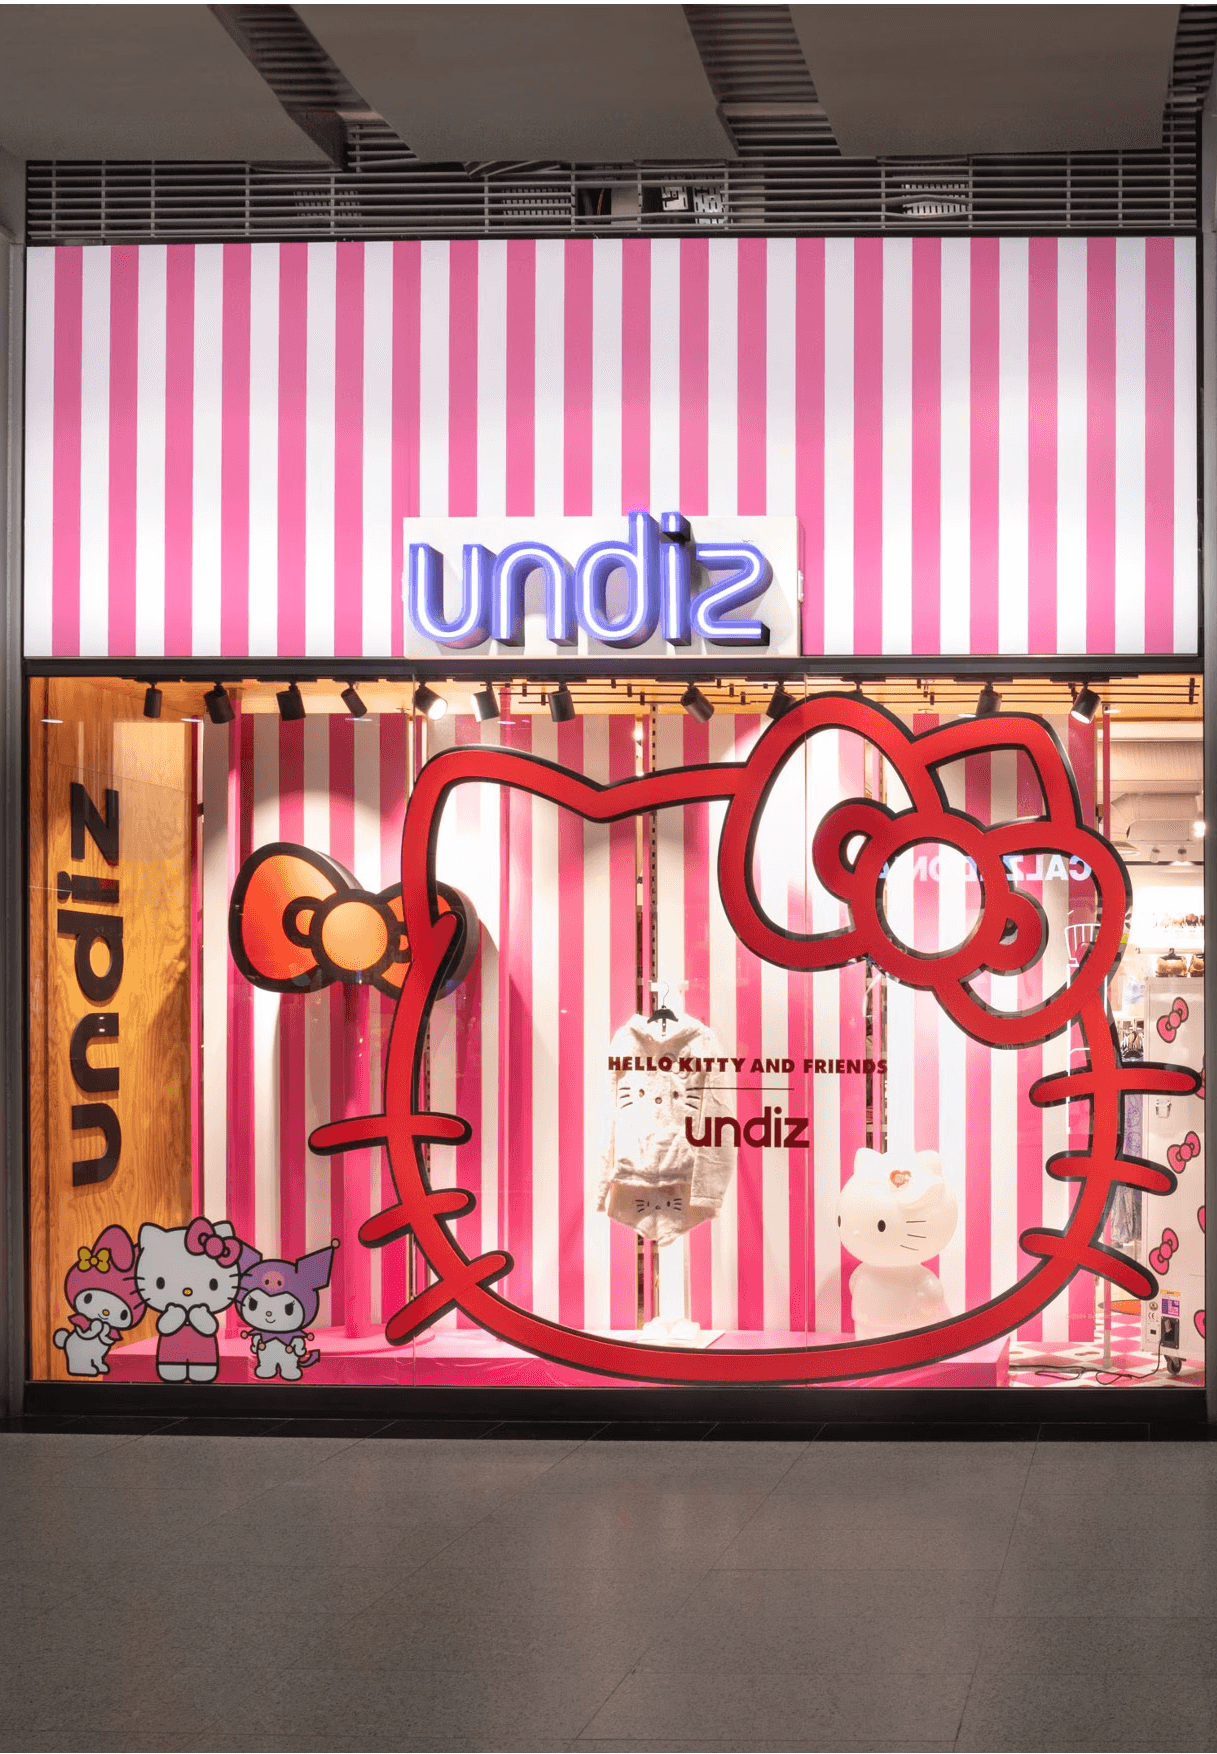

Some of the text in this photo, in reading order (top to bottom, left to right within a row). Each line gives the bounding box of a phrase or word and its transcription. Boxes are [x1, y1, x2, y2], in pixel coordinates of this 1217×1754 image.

[408, 511, 773, 649] undiz
[57, 782, 124, 1188] undiz
[607, 1056, 889, 1075] HELLO KITTY AND FRIENDS
[685, 1106, 810, 1149] undiz
